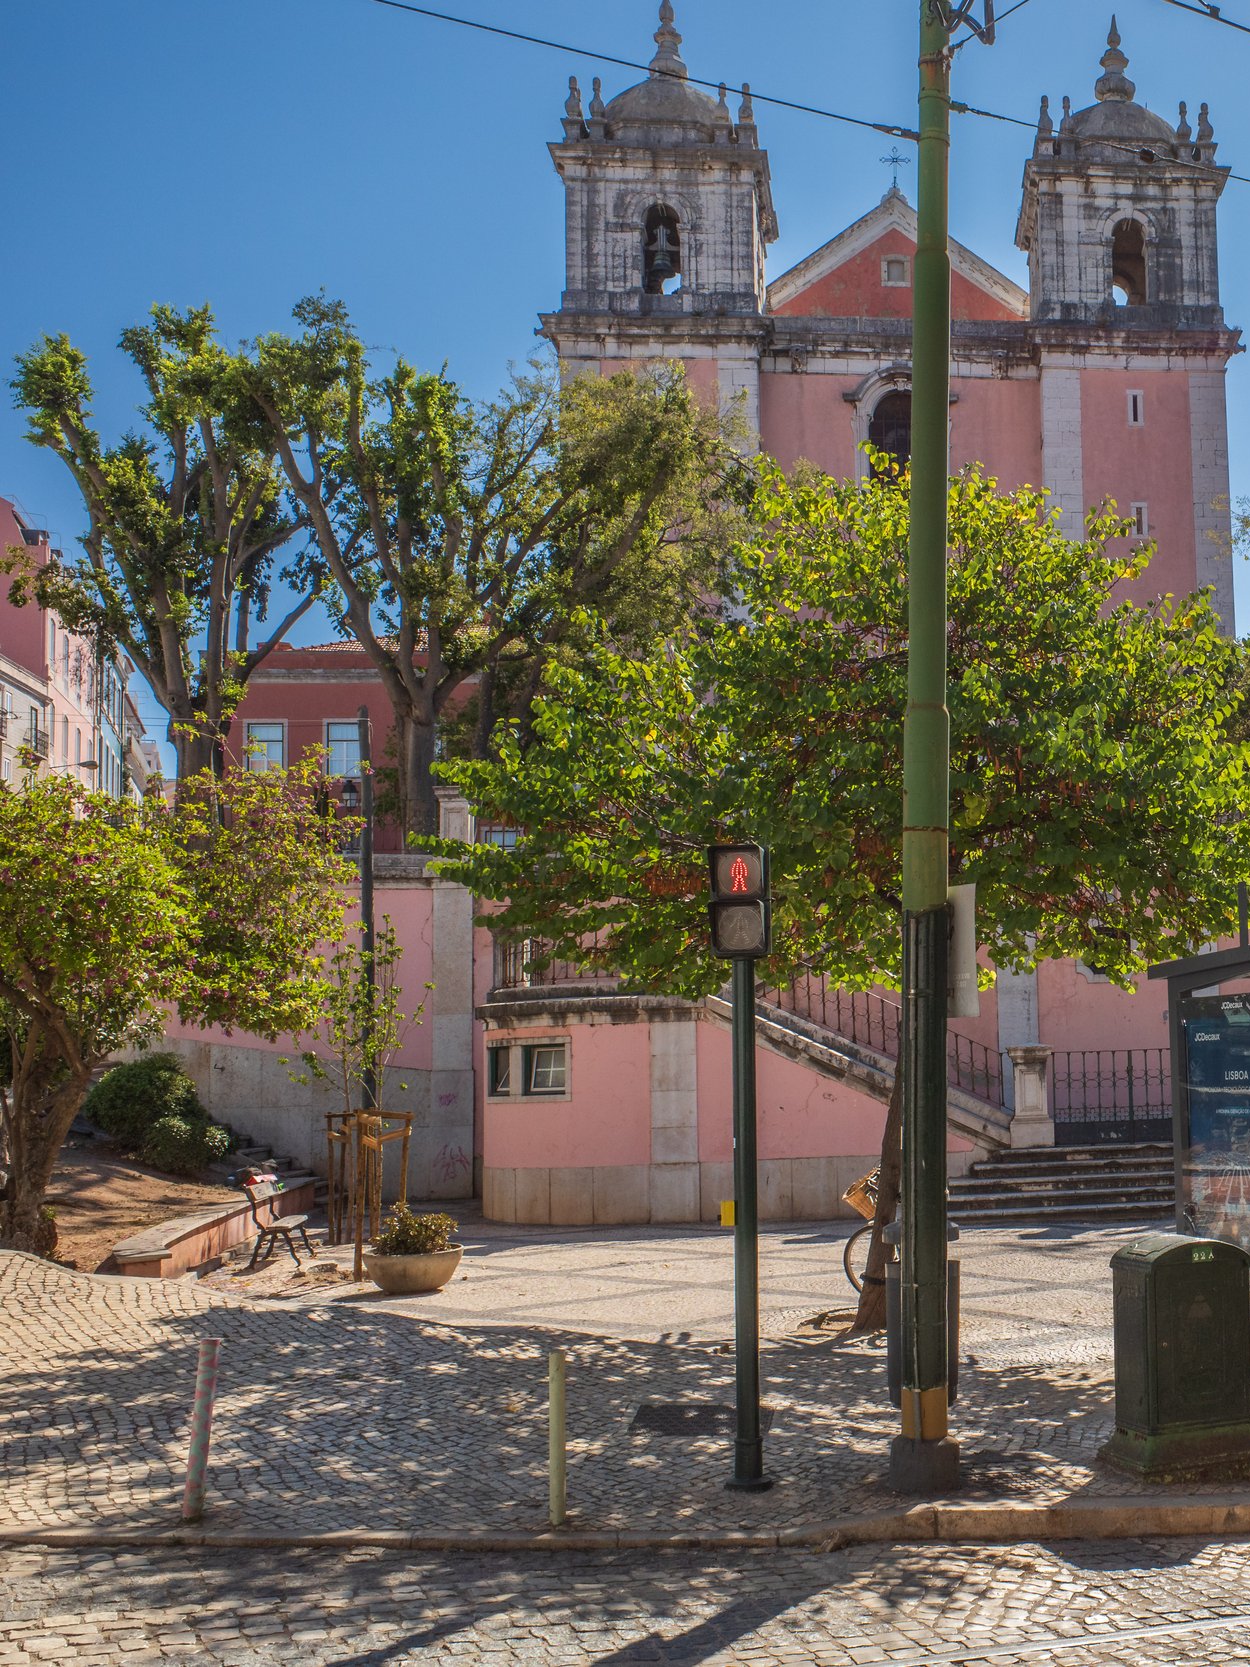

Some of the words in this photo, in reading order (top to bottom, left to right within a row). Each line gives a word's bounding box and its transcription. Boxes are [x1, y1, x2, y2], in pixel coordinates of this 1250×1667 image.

[1221, 1001, 1243, 1009] JCDecaux
[1194, 1032, 1220, 1042] JCDecaux
[1225, 1070, 1249, 1080] LISBOA
